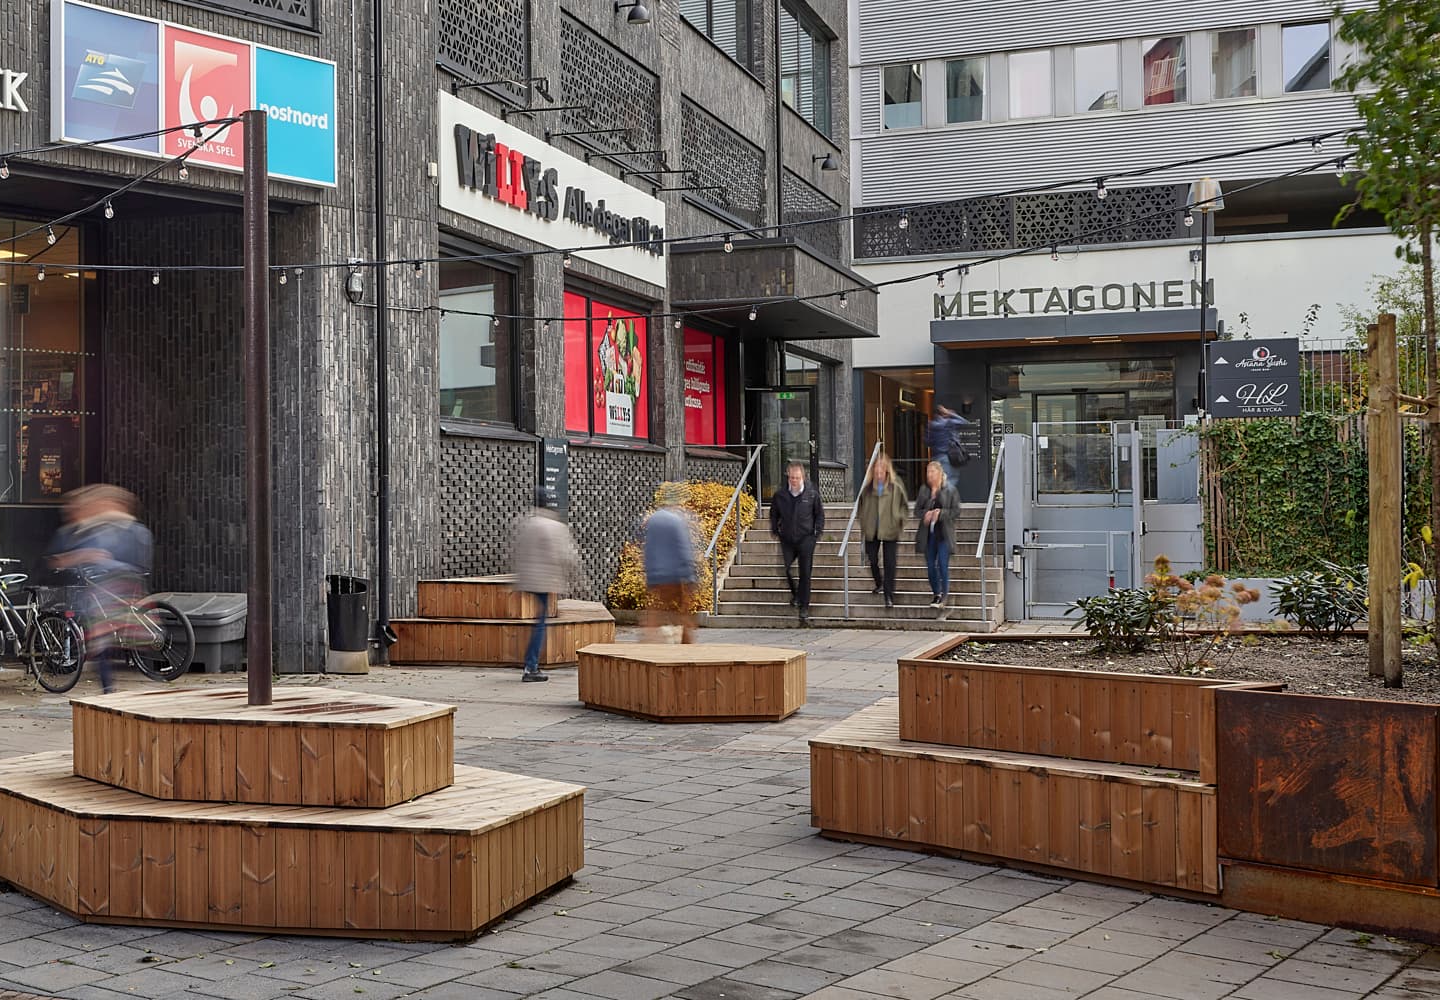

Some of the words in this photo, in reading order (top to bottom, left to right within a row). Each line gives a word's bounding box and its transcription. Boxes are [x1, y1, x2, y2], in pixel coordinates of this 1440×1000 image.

[85, 53, 105, 66] ATG
[216, 145, 236, 157] SPEL
[563, 186, 593, 228] Alla
[593, 199, 632, 245] dagar
[933, 278, 1214, 319] MEKTAGONEN
